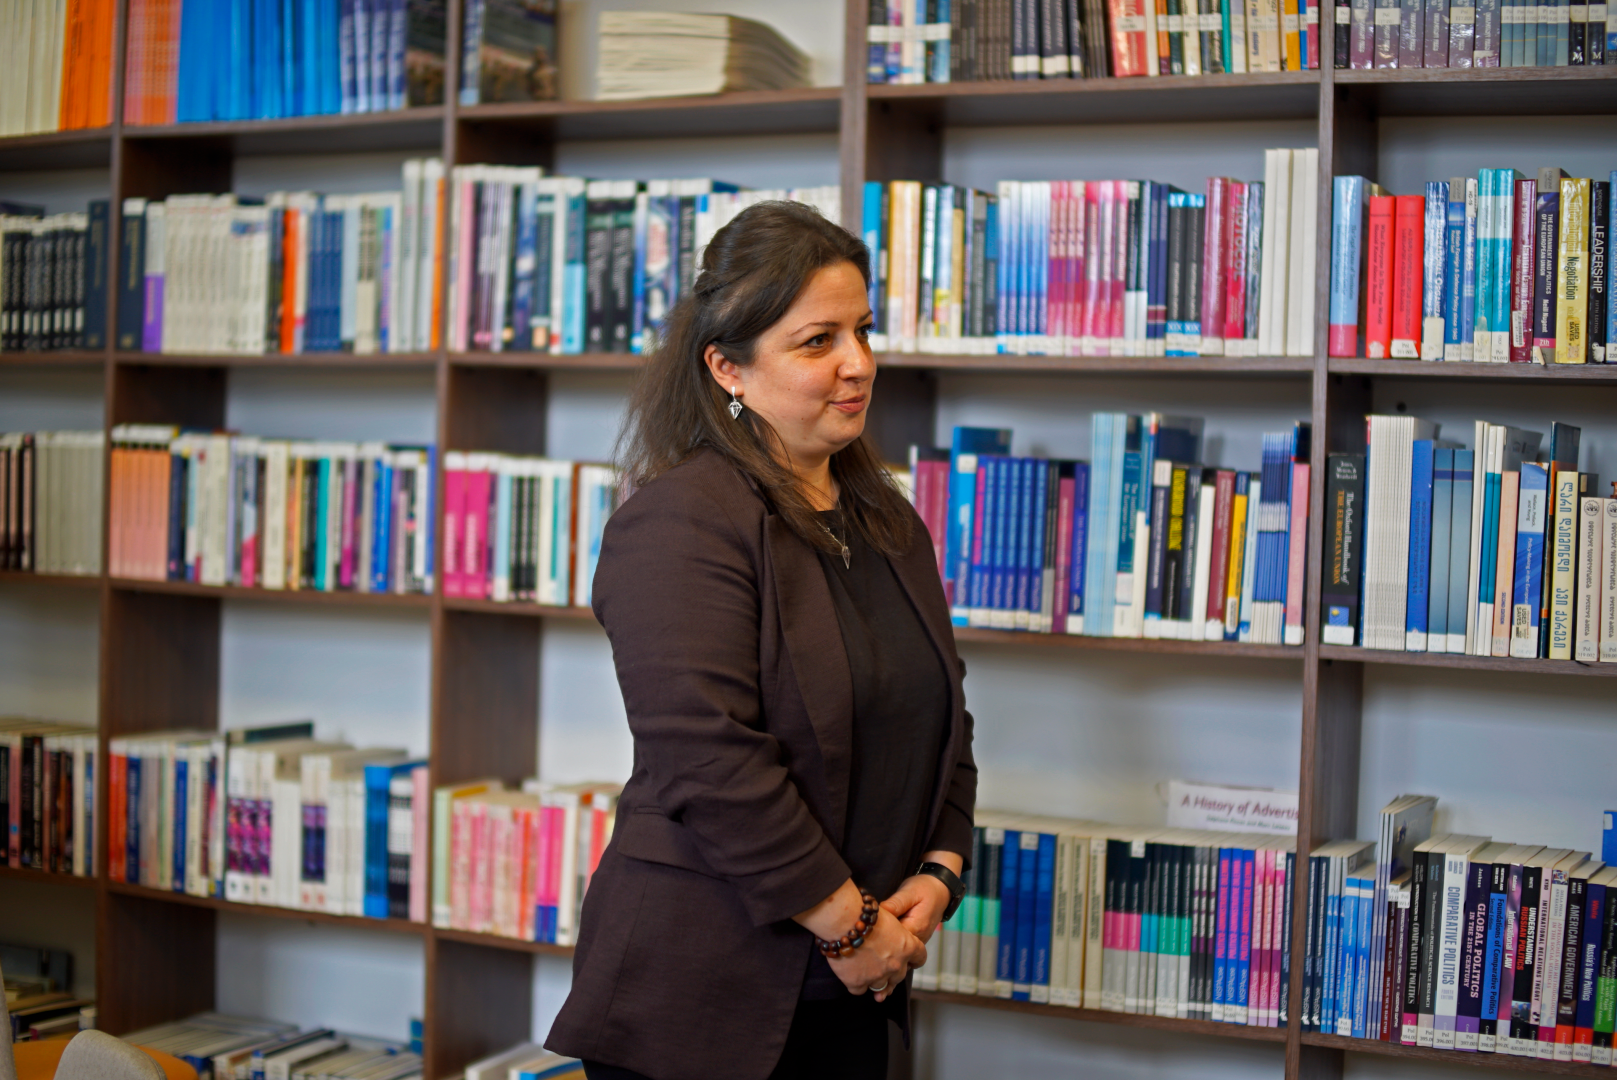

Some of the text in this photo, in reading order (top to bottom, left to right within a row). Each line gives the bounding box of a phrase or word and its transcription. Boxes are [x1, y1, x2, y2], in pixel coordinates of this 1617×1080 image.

[1565, 256, 1580, 300] Negotiation
[1593, 225, 1605, 293] LEADERSHIP
[1541, 313, 1549, 333] Nugent
[1335, 509, 1344, 554] EUROPEAN
[1341, 492, 1354, 585] The Oxford Handbook of
[1334, 556, 1342, 585] UNION
[1181, 793, 1299, 820] A History of Advertis
[1444, 886, 1461, 945] COMPARATIVE
[1469, 911, 1475, 920] IN
[1494, 899, 1504, 938] Foundations
[1539, 900, 1548, 944] INTERNATIONAL
[1567, 904, 1580, 945] AMERICAN
[1591, 900, 1599, 919] White
[1410, 922, 1419, 971] COMPARATIVE
[1470, 903, 1486, 998] GLOBAL POLITICS
[1504, 910, 1516, 968] International LAW
[1516, 906, 1528, 970] RUSSIAN POLITICS
[1524, 907, 1536, 964] UNDERSTANDING
[1442, 948, 1456, 985] POLITICS
[1491, 949, 1500, 990] Comparative
[1536, 947, 1544, 978] RELATIONS
[1563, 947, 1577, 999] GOVERNMENT
[1582, 944, 1596, 1001] Russia's New Politics
[1408, 972, 1417, 1004] POLITICS
[1488, 991, 1497, 1014] Politics
